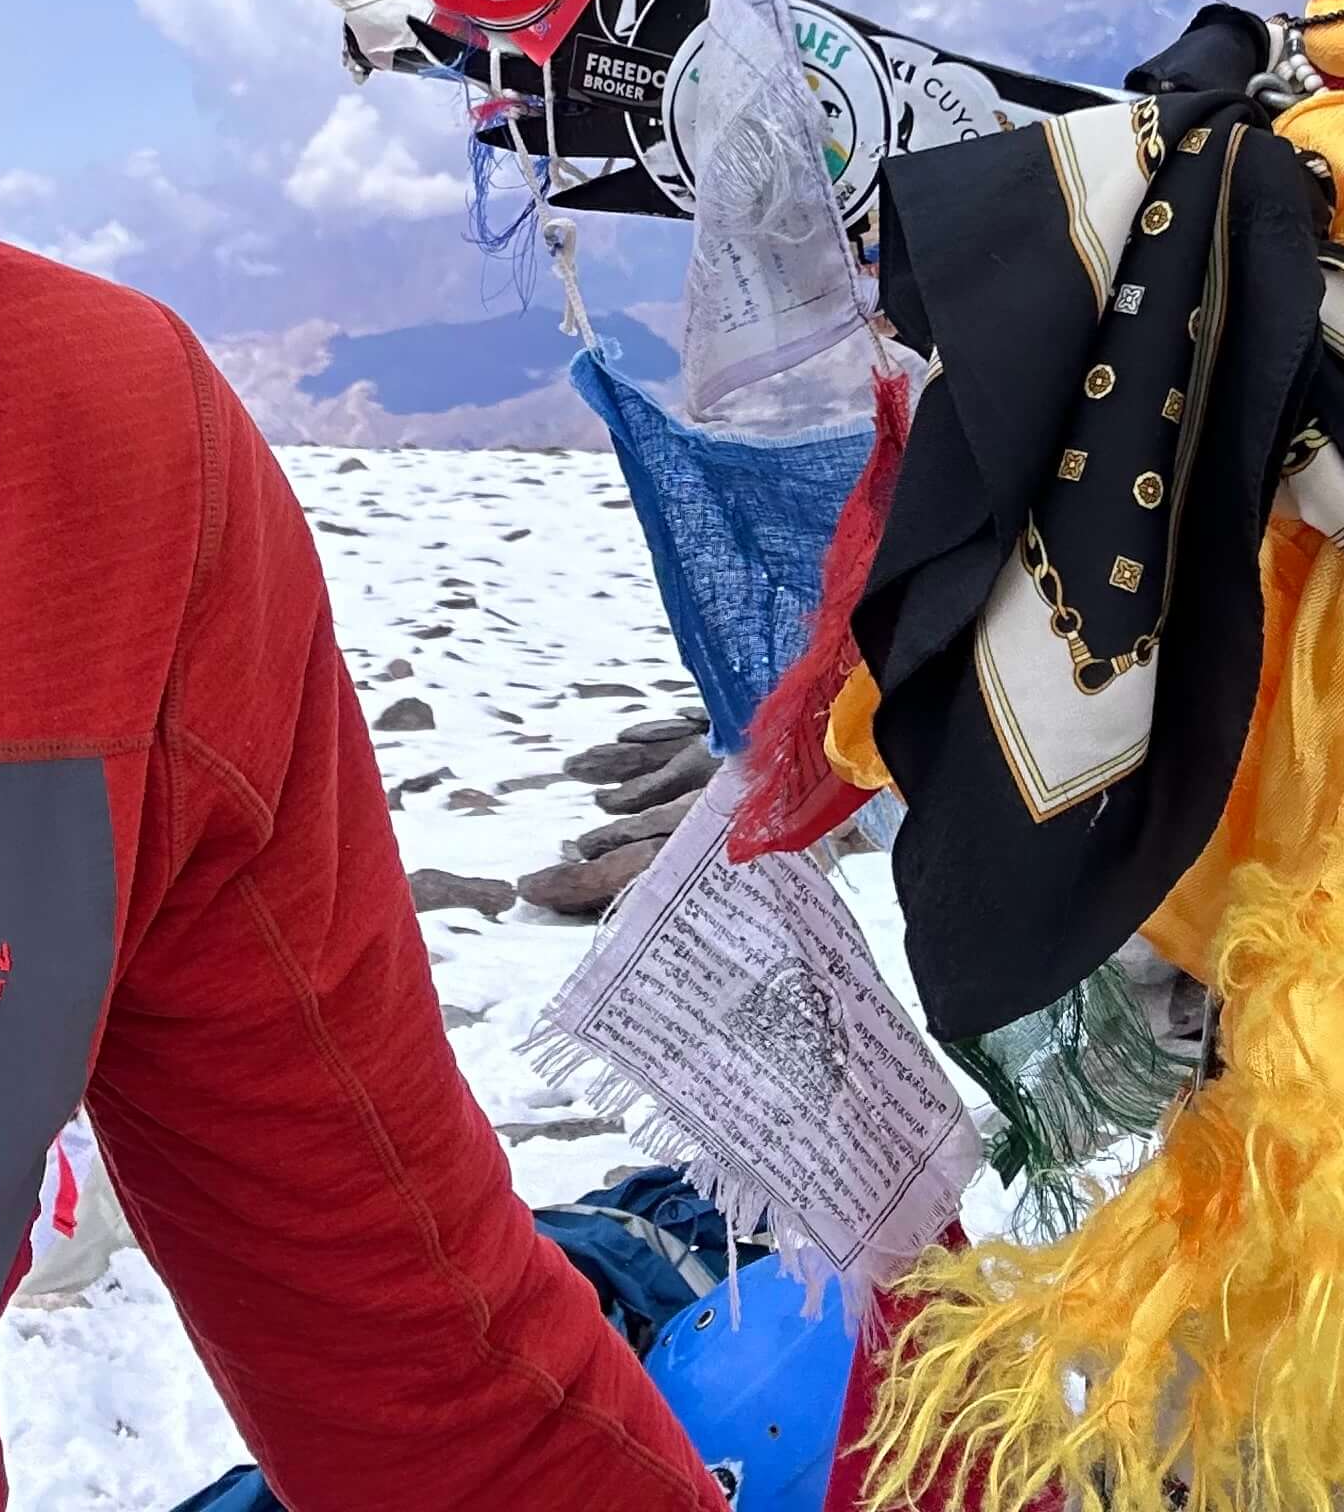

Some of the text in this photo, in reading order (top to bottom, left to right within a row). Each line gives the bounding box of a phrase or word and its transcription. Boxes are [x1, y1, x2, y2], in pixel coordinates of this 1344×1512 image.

[795, 22, 851, 70] UES
[582, 73, 645, 101] BROKER
[585, 52, 668, 89] FREEDO
